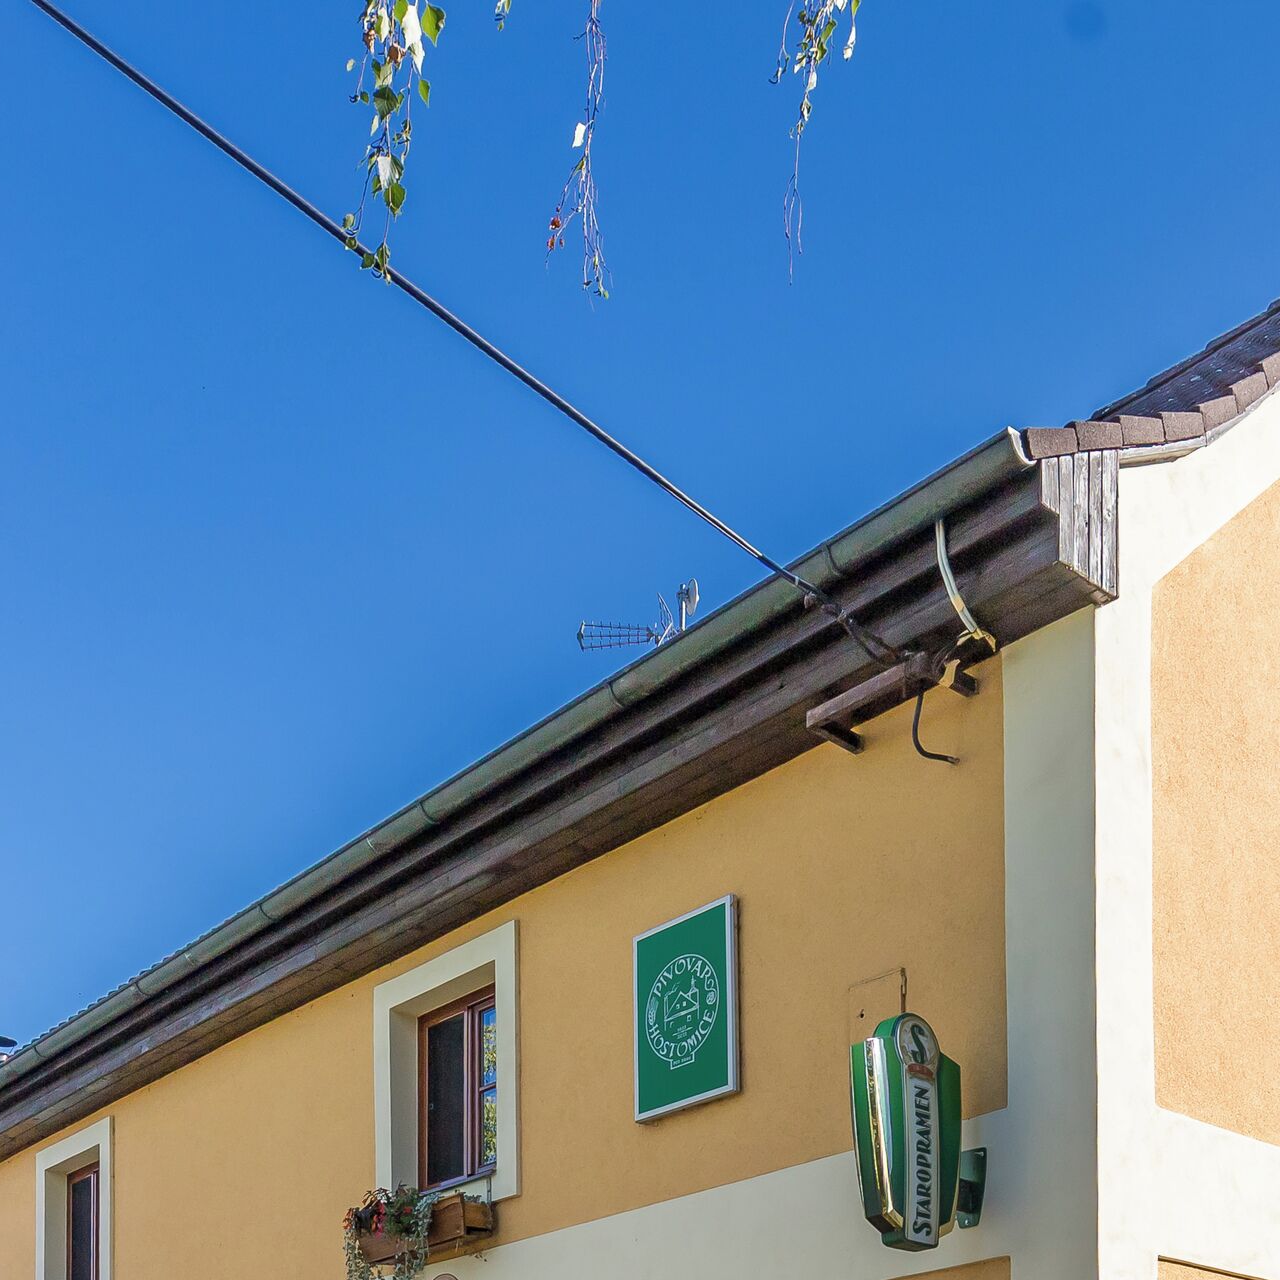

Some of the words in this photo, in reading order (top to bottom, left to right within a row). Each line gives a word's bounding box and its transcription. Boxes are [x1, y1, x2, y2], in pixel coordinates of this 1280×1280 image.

[653, 957, 712, 997] PIVOVAR
[649, 1009, 714, 1058] HOSTOMICE
[912, 1085, 932, 1237] STAROPRAMEN
